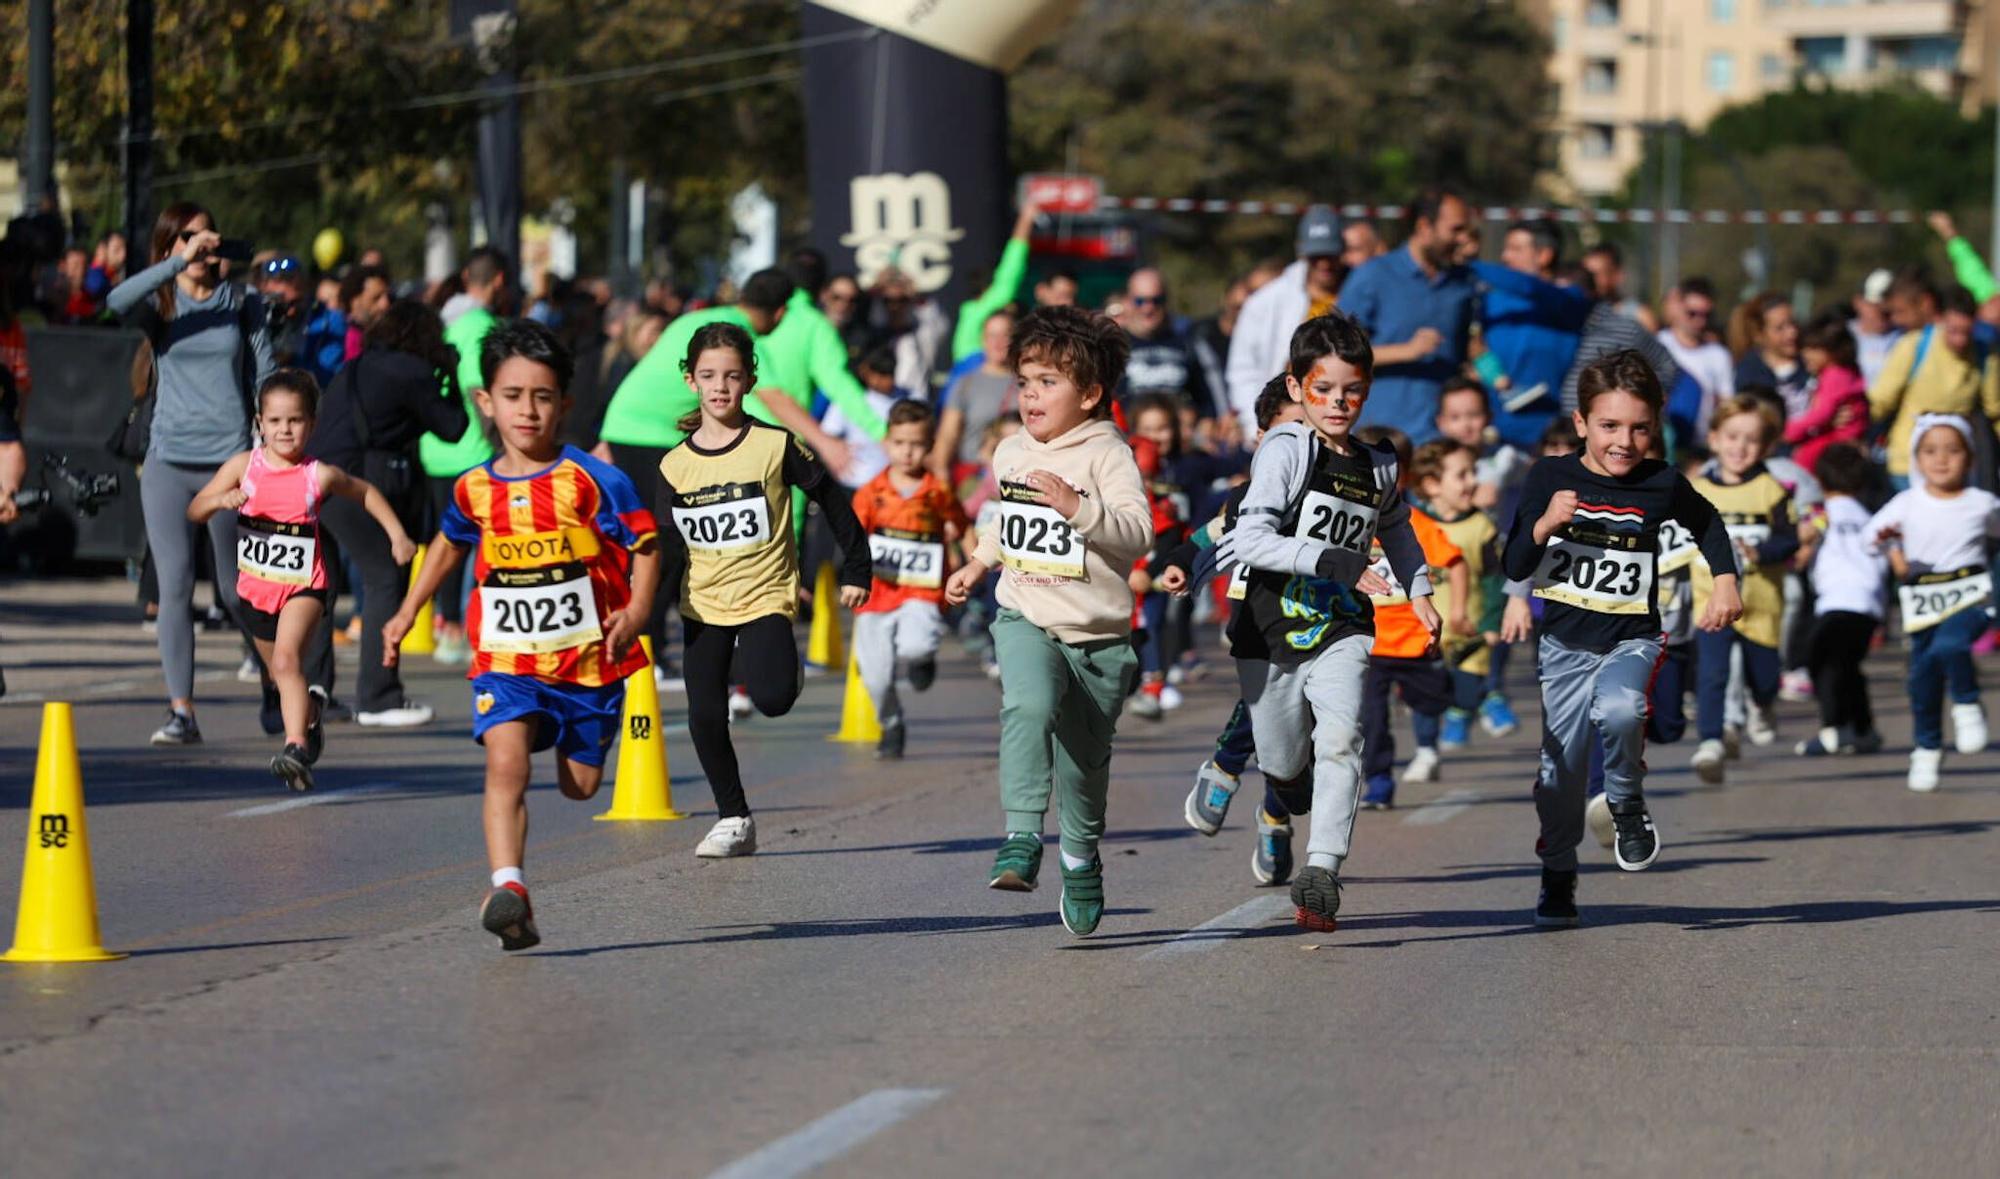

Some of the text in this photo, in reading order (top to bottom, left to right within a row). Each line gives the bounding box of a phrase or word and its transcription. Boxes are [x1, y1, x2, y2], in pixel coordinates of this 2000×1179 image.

[682, 509, 759, 543] 2023
[242, 535, 305, 570] 2023
[493, 535, 574, 560] OYOTA
[875, 545, 932, 573] 2023
[1547, 549, 1642, 596] 2023
[494, 591, 583, 633] 2023
